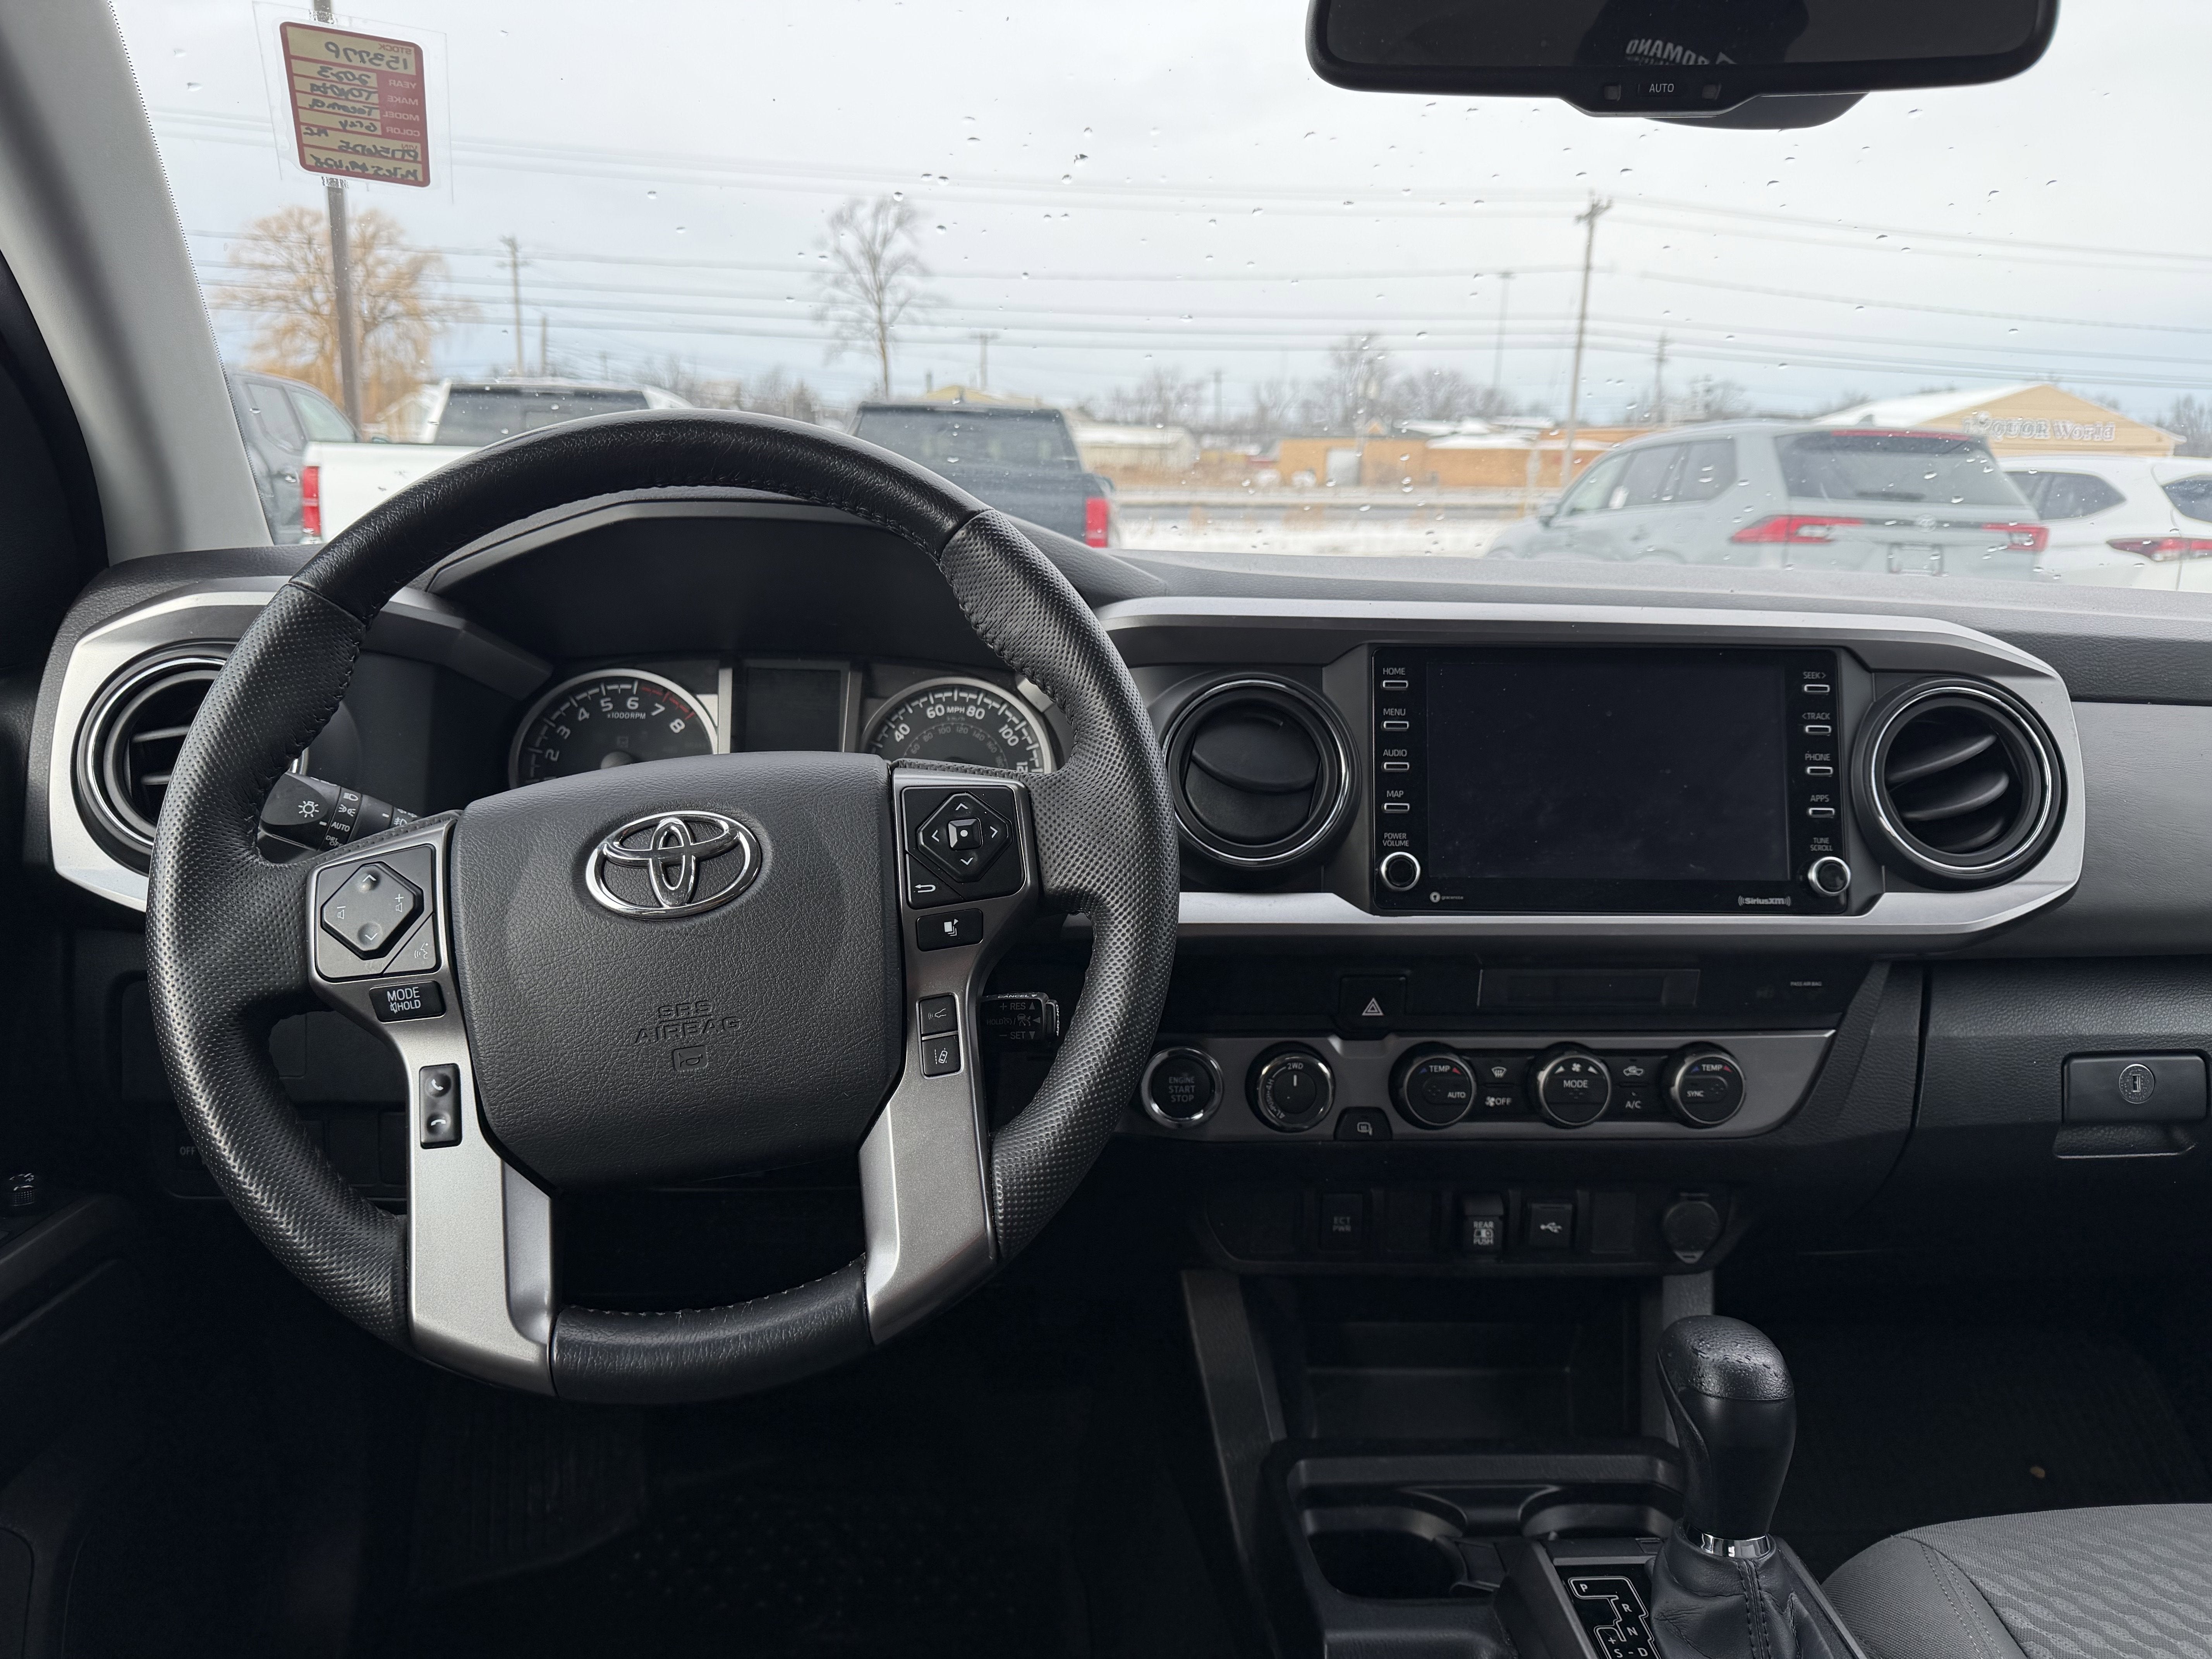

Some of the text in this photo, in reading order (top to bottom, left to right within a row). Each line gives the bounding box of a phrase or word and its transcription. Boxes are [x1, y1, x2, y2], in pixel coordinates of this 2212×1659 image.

[1649, 83, 1675, 93] AUTO
[599, 697, 613, 712] 5
[626, 696, 639, 710] 6
[578, 707, 590, 722] 4
[651, 703, 665, 716] 7
[926, 703, 945, 719] 60
[946, 706, 965, 714] MPH
[966, 705, 986, 720] 80
[1383, 708, 1406, 716] MENU
[670, 718, 685, 734] 8
[556, 724, 571, 740] 3
[894, 723, 911, 743] 40
[998, 724, 1019, 747] 100
[545, 749, 560, 762] 2
[1383, 749, 1407, 757] AUDIO
[1805, 753, 1831, 761] PHONE
[1386, 790, 1404, 798] MAP
[1810, 794, 1830, 803] APPS
[331, 821, 350, 832] AUTO
[386, 987, 421, 1002] MODE
[397, 999, 422, 1011] HOLD
[658, 1000, 712, 1018] SRS
[1010, 1002, 1026, 1010] RES
[634, 1016, 740, 1044] AIRBAG
[1010, 1031, 1026, 1039] SET
[1286, 1062, 1304, 1070] 2WD
[1429, 1064, 1450, 1073] TEMP
[1701, 1064, 1723, 1072] TEMP
[1563, 1079, 1589, 1089] MODE
[1168, 1085, 1195, 1094] START
[1687, 1090, 1704, 1098] SYNC
[1170, 1094, 1195, 1103] STOP
[1447, 1091, 1466, 1099] AUTO
[1495, 1097, 1512, 1106] OFF
[1625, 1100, 1642, 1110] A/C
[1580, 1583, 1589, 1593] P
[1621, 1603, 1633, 1613] R
[1626, 1626, 1638, 1636] N
[1614, 1647, 1649, 1658] S D
